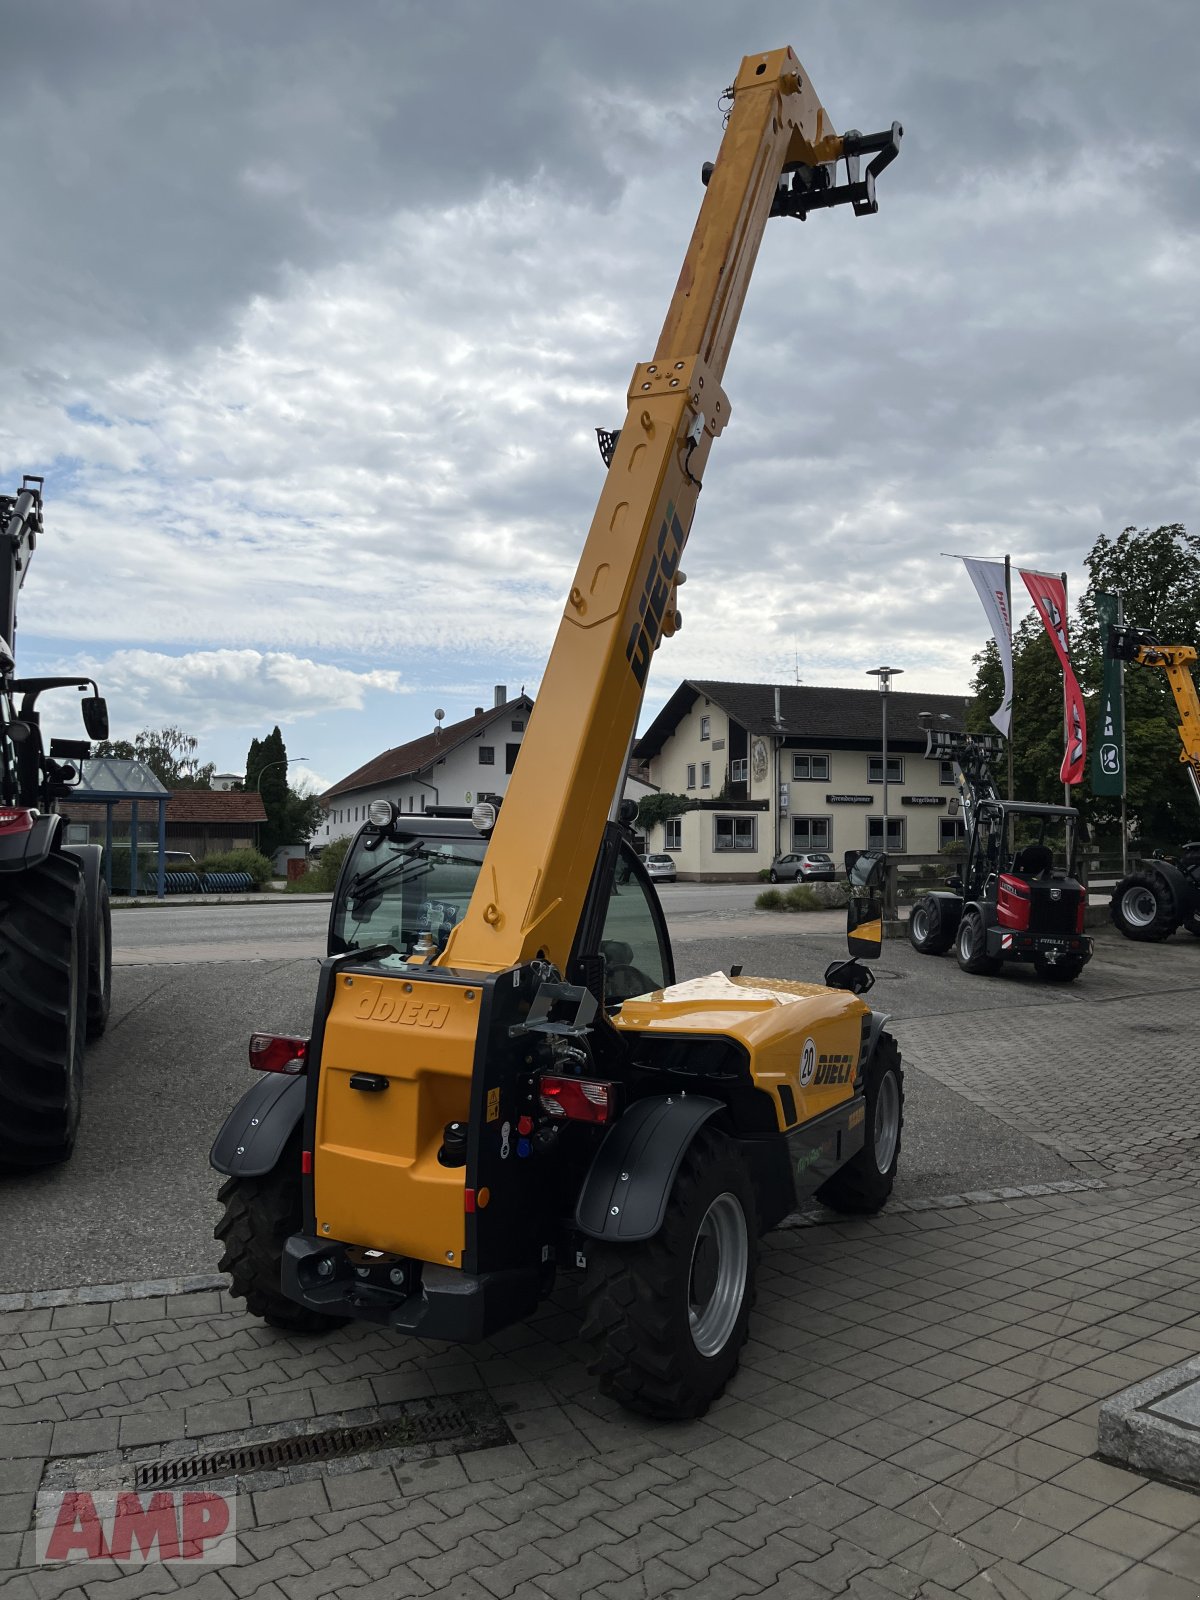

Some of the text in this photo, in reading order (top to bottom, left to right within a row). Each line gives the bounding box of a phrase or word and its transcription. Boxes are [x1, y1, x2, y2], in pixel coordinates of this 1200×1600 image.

[625, 500, 684, 688] DIECI
[802, 1047, 814, 1077] 20
[813, 1054, 853, 1085] DIECI
